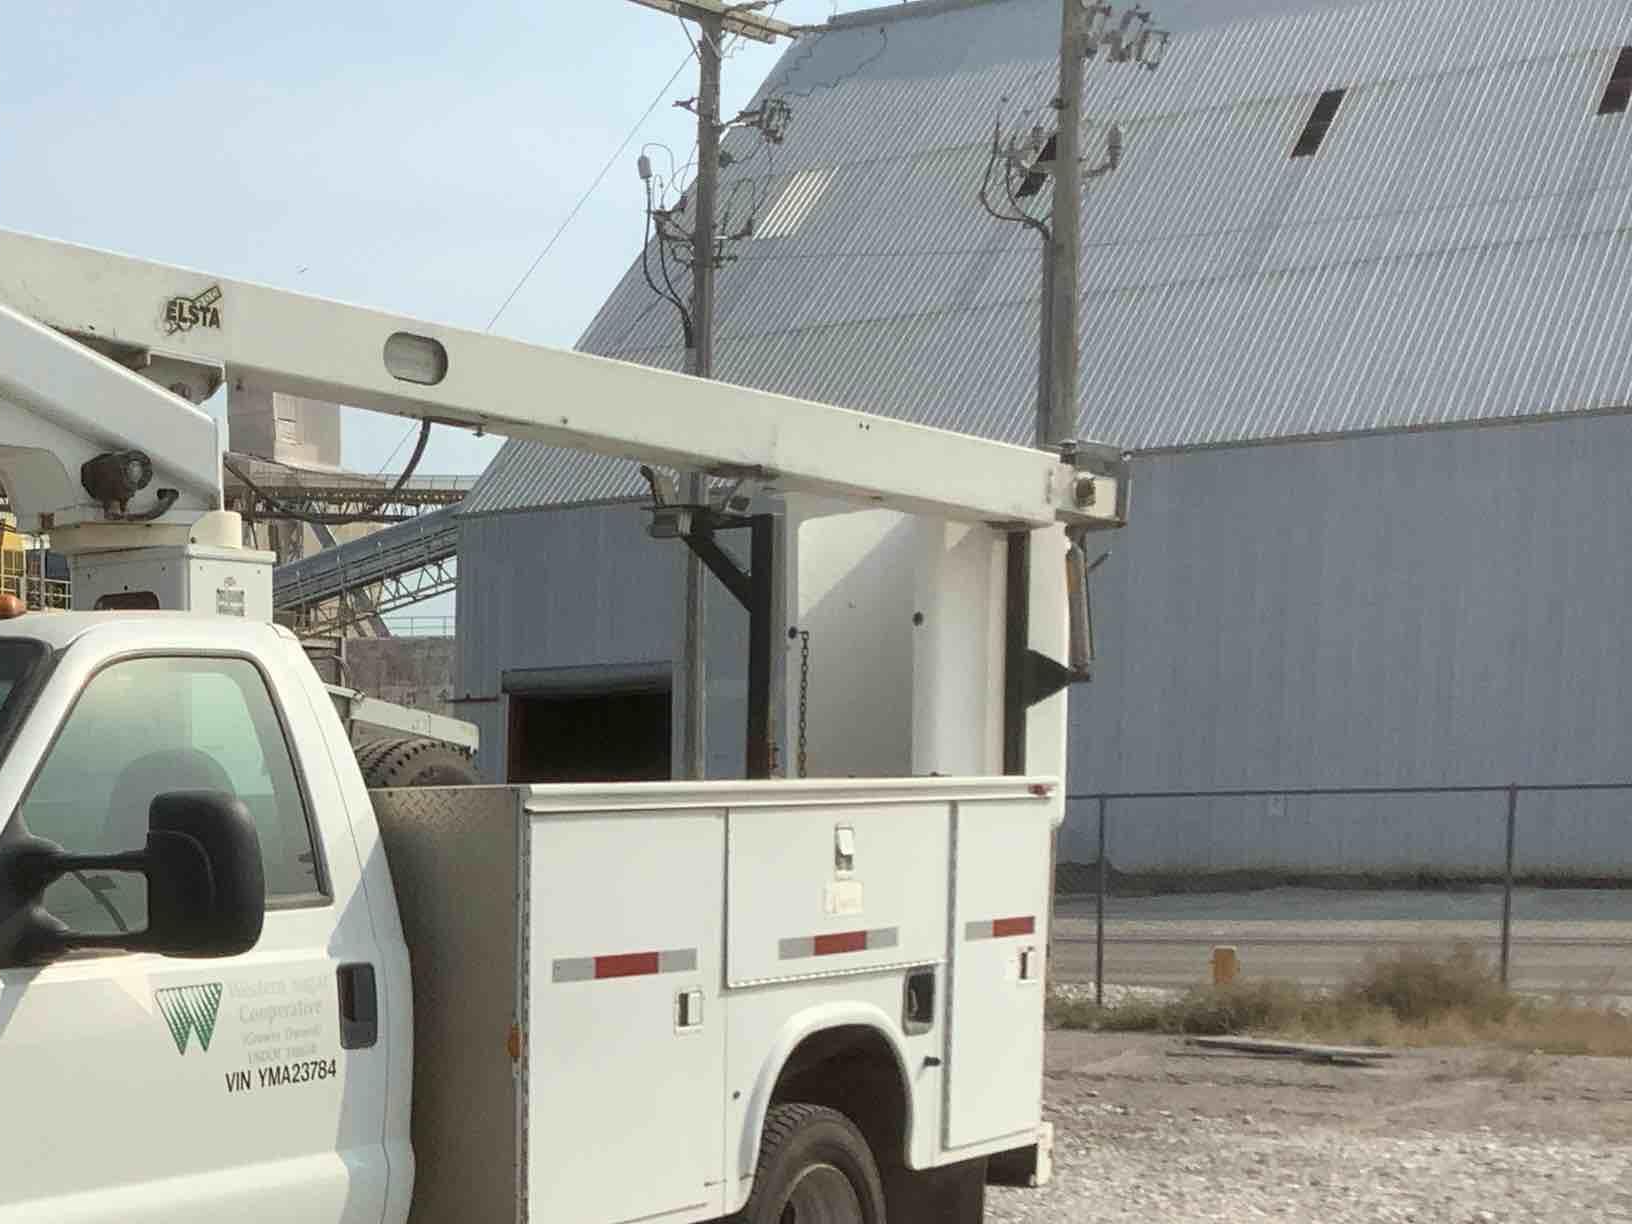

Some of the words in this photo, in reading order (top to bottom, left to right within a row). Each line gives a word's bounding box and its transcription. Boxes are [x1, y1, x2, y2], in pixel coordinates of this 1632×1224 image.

[166, 300, 220, 329] ELSTA
[225, 1070, 252, 1093] VIN
[257, 1059, 336, 1088] YMA23784
